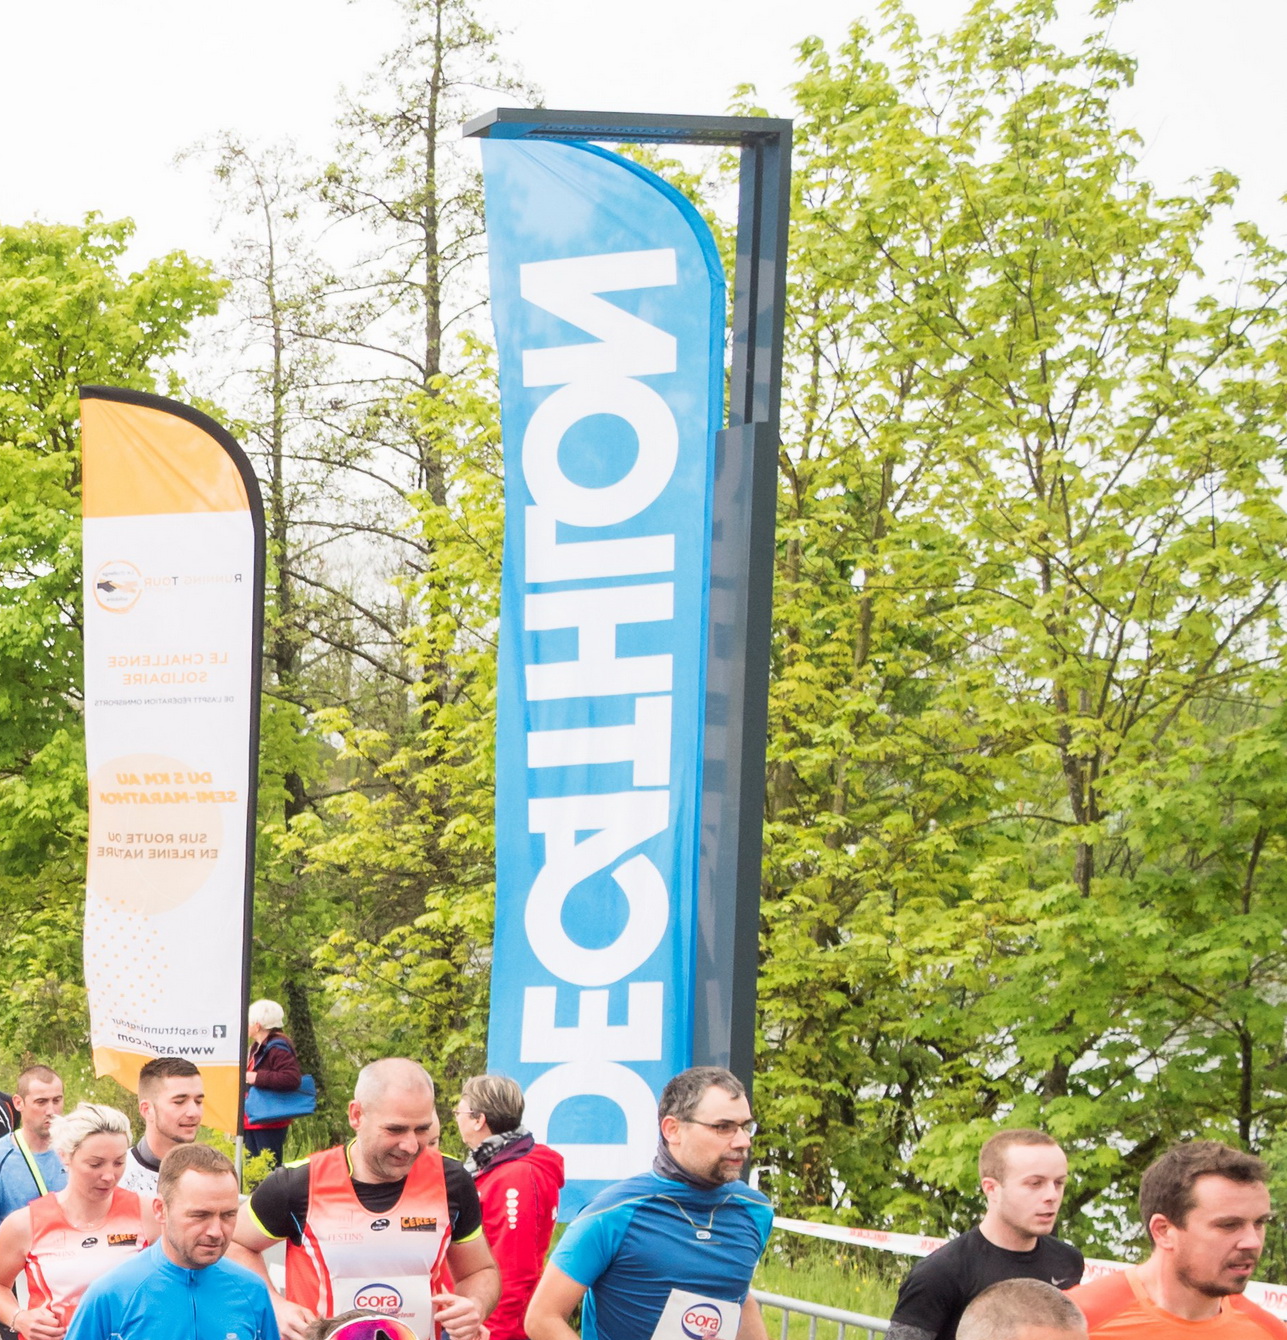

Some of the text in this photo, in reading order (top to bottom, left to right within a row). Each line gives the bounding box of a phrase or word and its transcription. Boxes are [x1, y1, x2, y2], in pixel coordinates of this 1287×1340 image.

[401, 1217, 436, 1228] CERES
[107, 1234, 138, 1244] CERES
[357, 1296, 398, 1307] cora
[685, 1312, 719, 1330] cora
